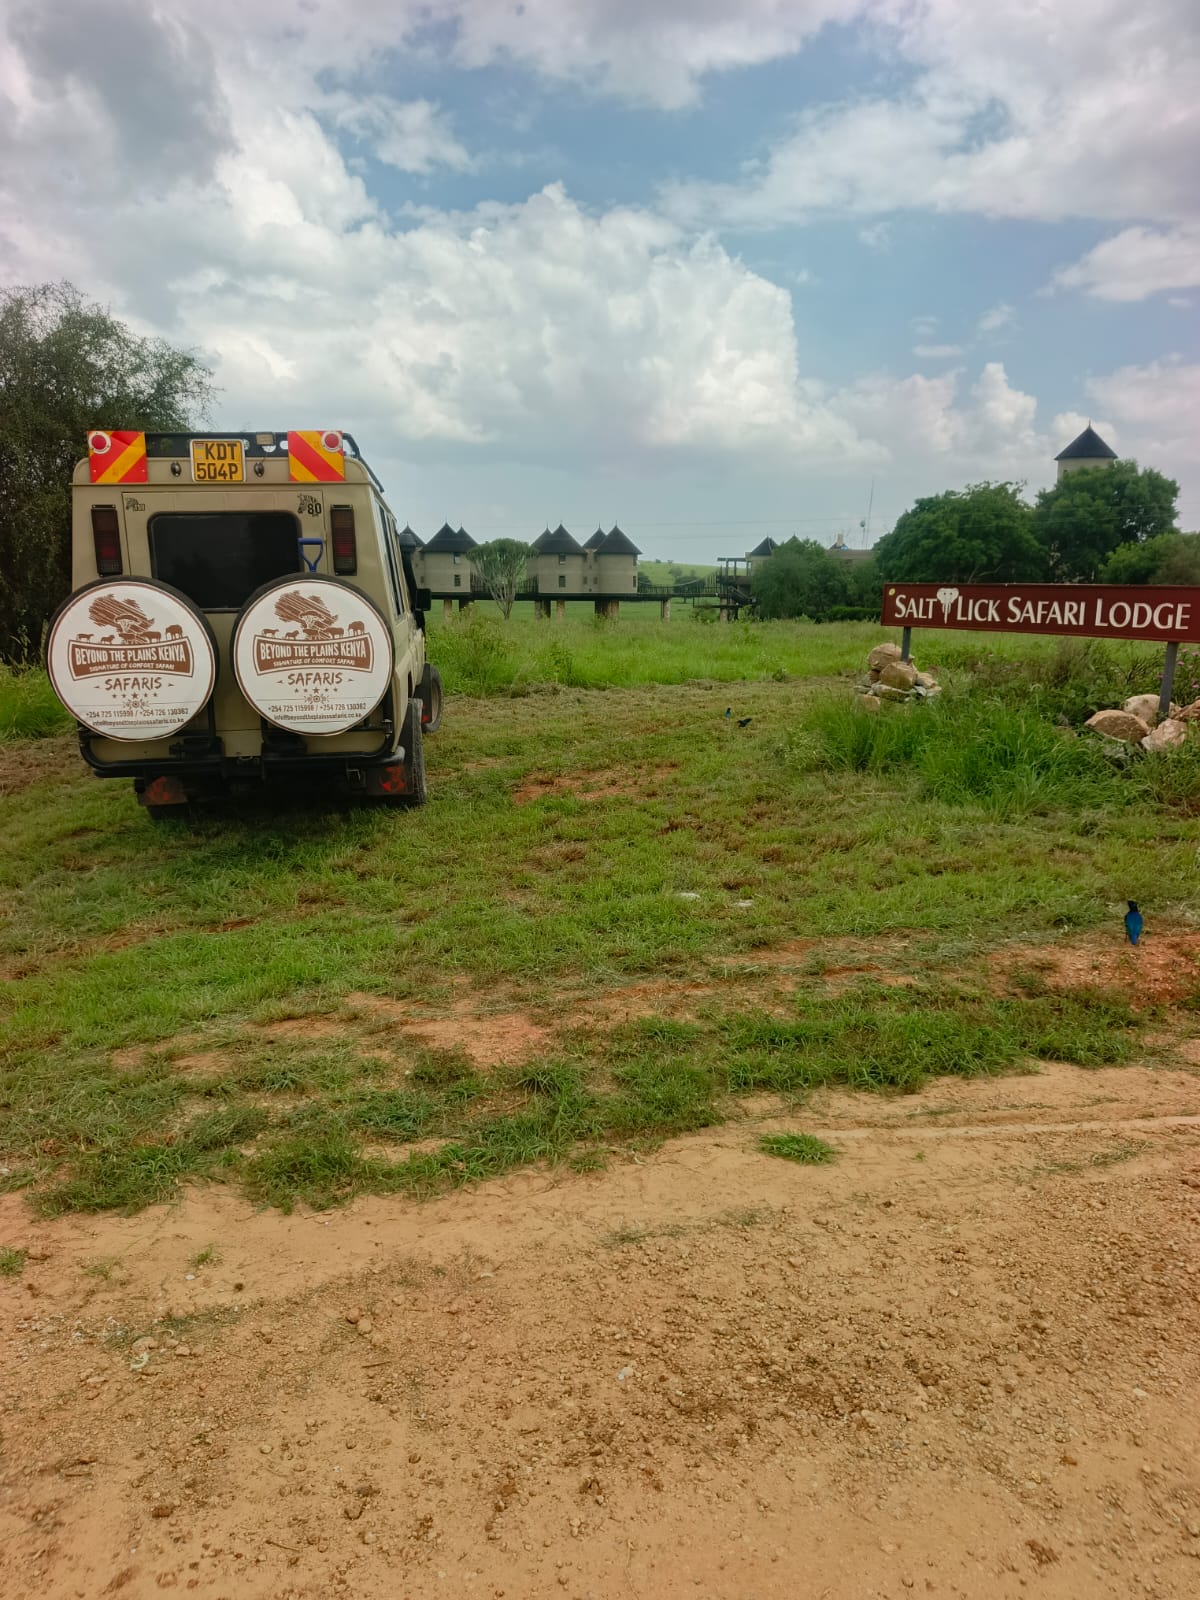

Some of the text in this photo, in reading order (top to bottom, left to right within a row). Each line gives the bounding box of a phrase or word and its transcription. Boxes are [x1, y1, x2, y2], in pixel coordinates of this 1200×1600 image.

[205, 441, 238, 461] KDT
[196, 462, 239, 481] 504P
[307, 502, 322, 515] 80
[895, 594, 1192, 630] SALT LICK SAFARI LODGE
[75, 644, 186, 665] BEYOND THE PLAINS KENYA
[260, 640, 366, 660] BEYOND THE PLAINS KENYA
[89, 664, 119, 672] SIGNATURE
[273, 659, 303, 667] SIGNATURE
[105, 677, 163, 691] SAFARIS
[287, 672, 344, 686] SAFARIS
